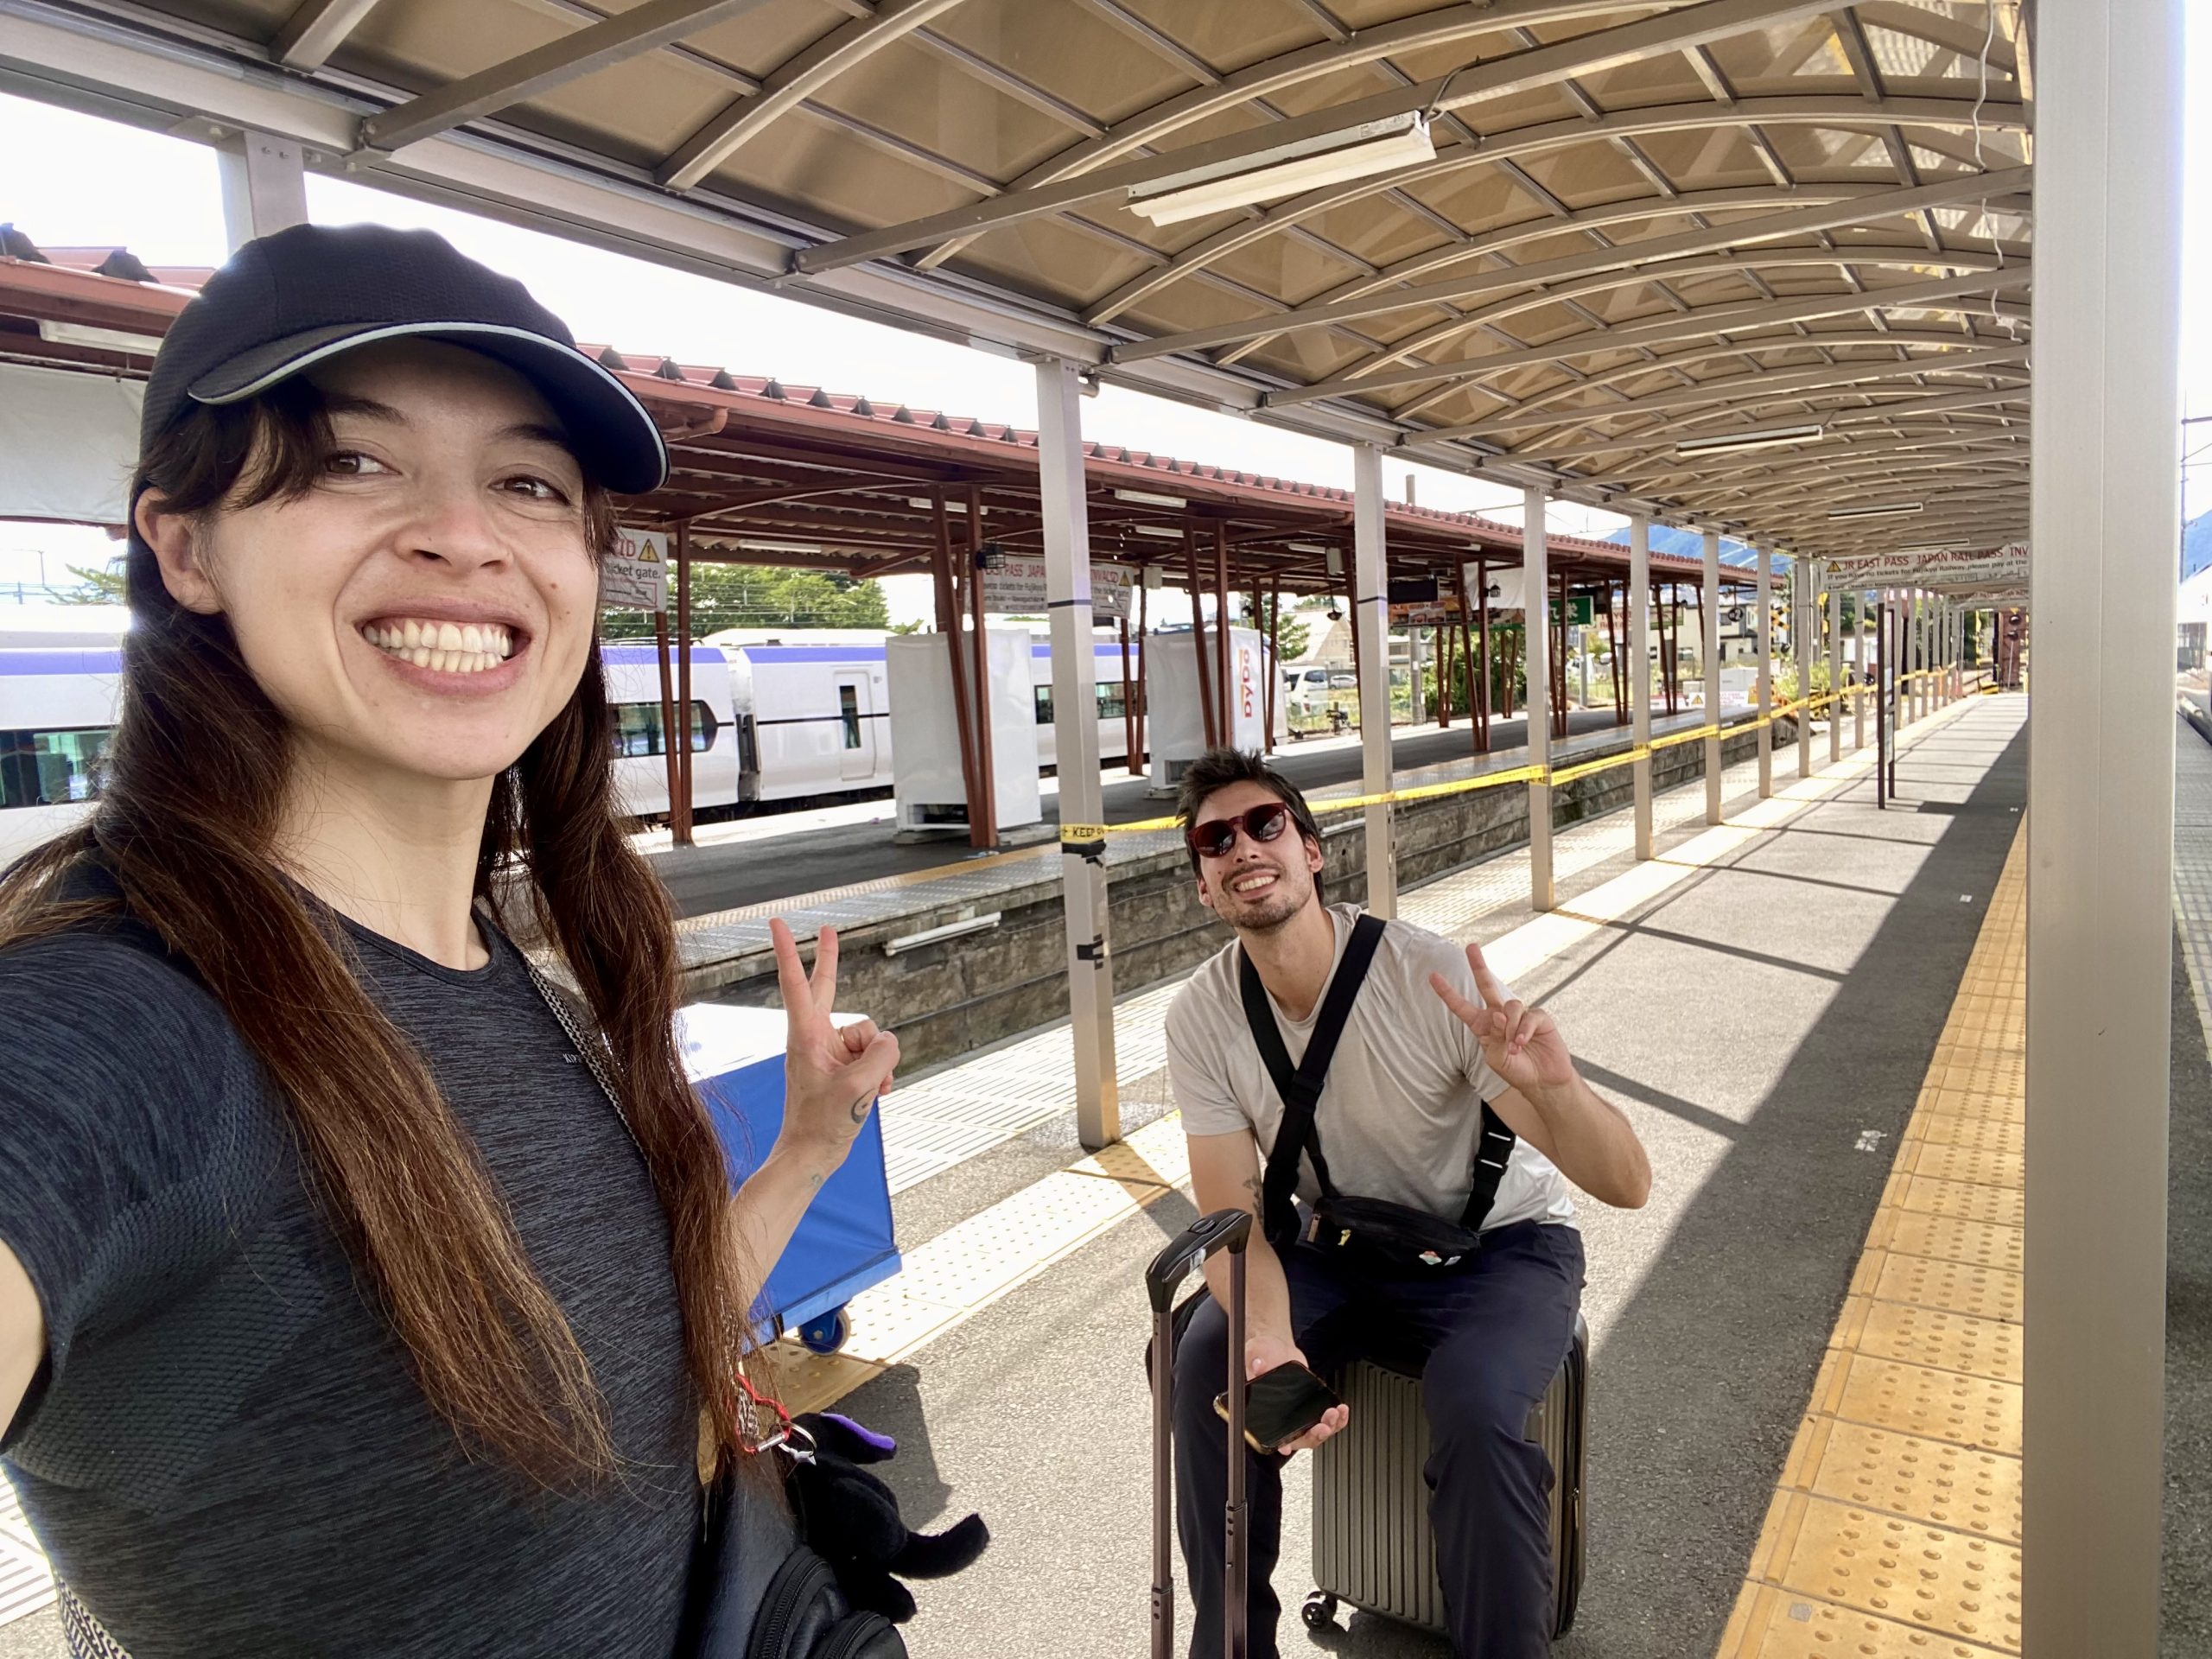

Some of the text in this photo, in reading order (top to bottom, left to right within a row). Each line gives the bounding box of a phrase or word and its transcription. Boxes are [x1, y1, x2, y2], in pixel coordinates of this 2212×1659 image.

[1843, 560, 1854, 570] JR
[1857, 557, 1881, 569] EAST
[1884, 555, 1909, 567] PASS
[1916, 552, 1948, 565] JAPAN
[1951, 549, 1972, 562] RAIL
[1977, 548, 2004, 560] PASS
[1992, 561, 2005, 569] pay
[635, 569, 661, 579] gate.
[1072, 826, 1095, 837] KEEP
